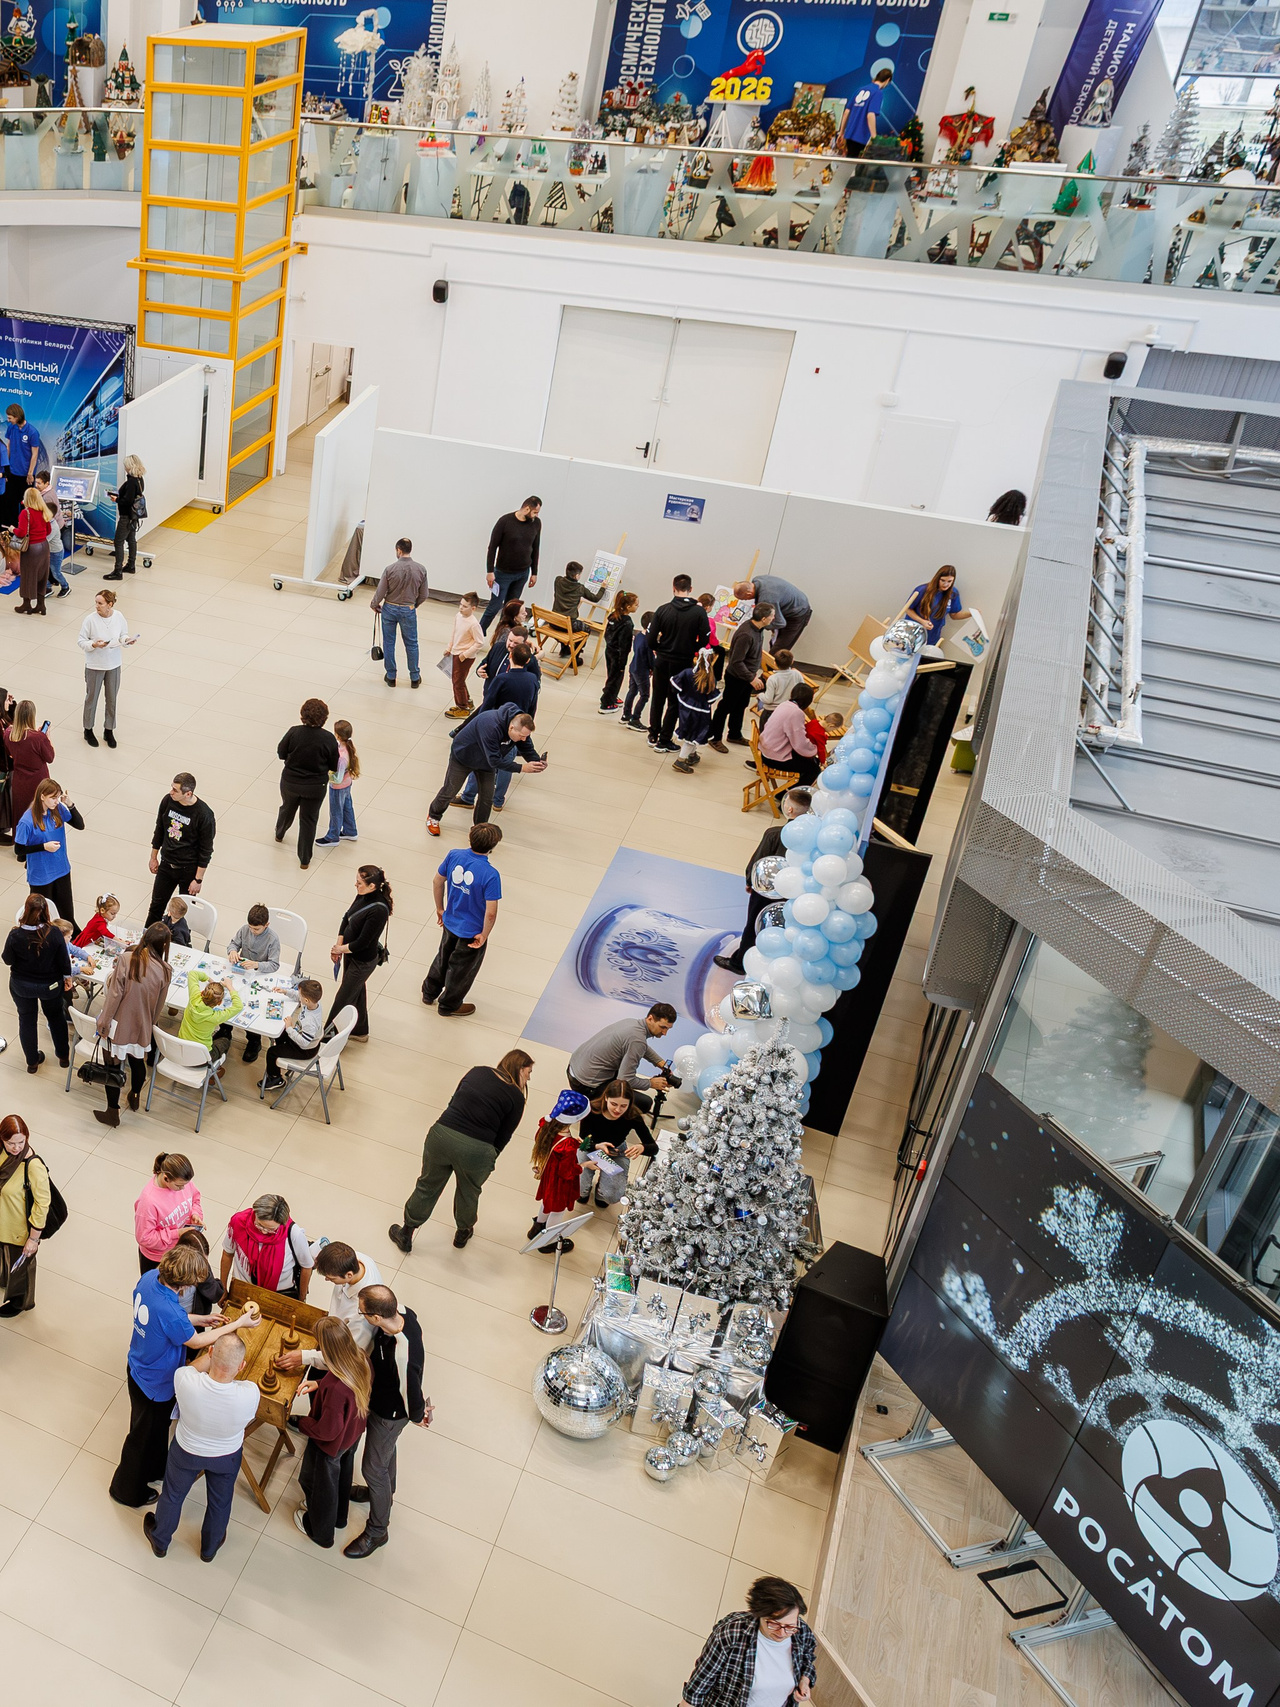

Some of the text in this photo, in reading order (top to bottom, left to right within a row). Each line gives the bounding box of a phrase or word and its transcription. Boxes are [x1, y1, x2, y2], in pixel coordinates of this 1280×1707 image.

[1070, 19, 1118, 124] ДЕТСКИЙ ТЕХНОП
[709, 76, 773, 101] 2026
[4, 335, 43, 346] Республики
[44, 340, 75, 350] Беларусь
[8, 370, 61, 385] ТЕХНОПАРК
[1052, 1486, 1255, 1707] РОСАТОМ
